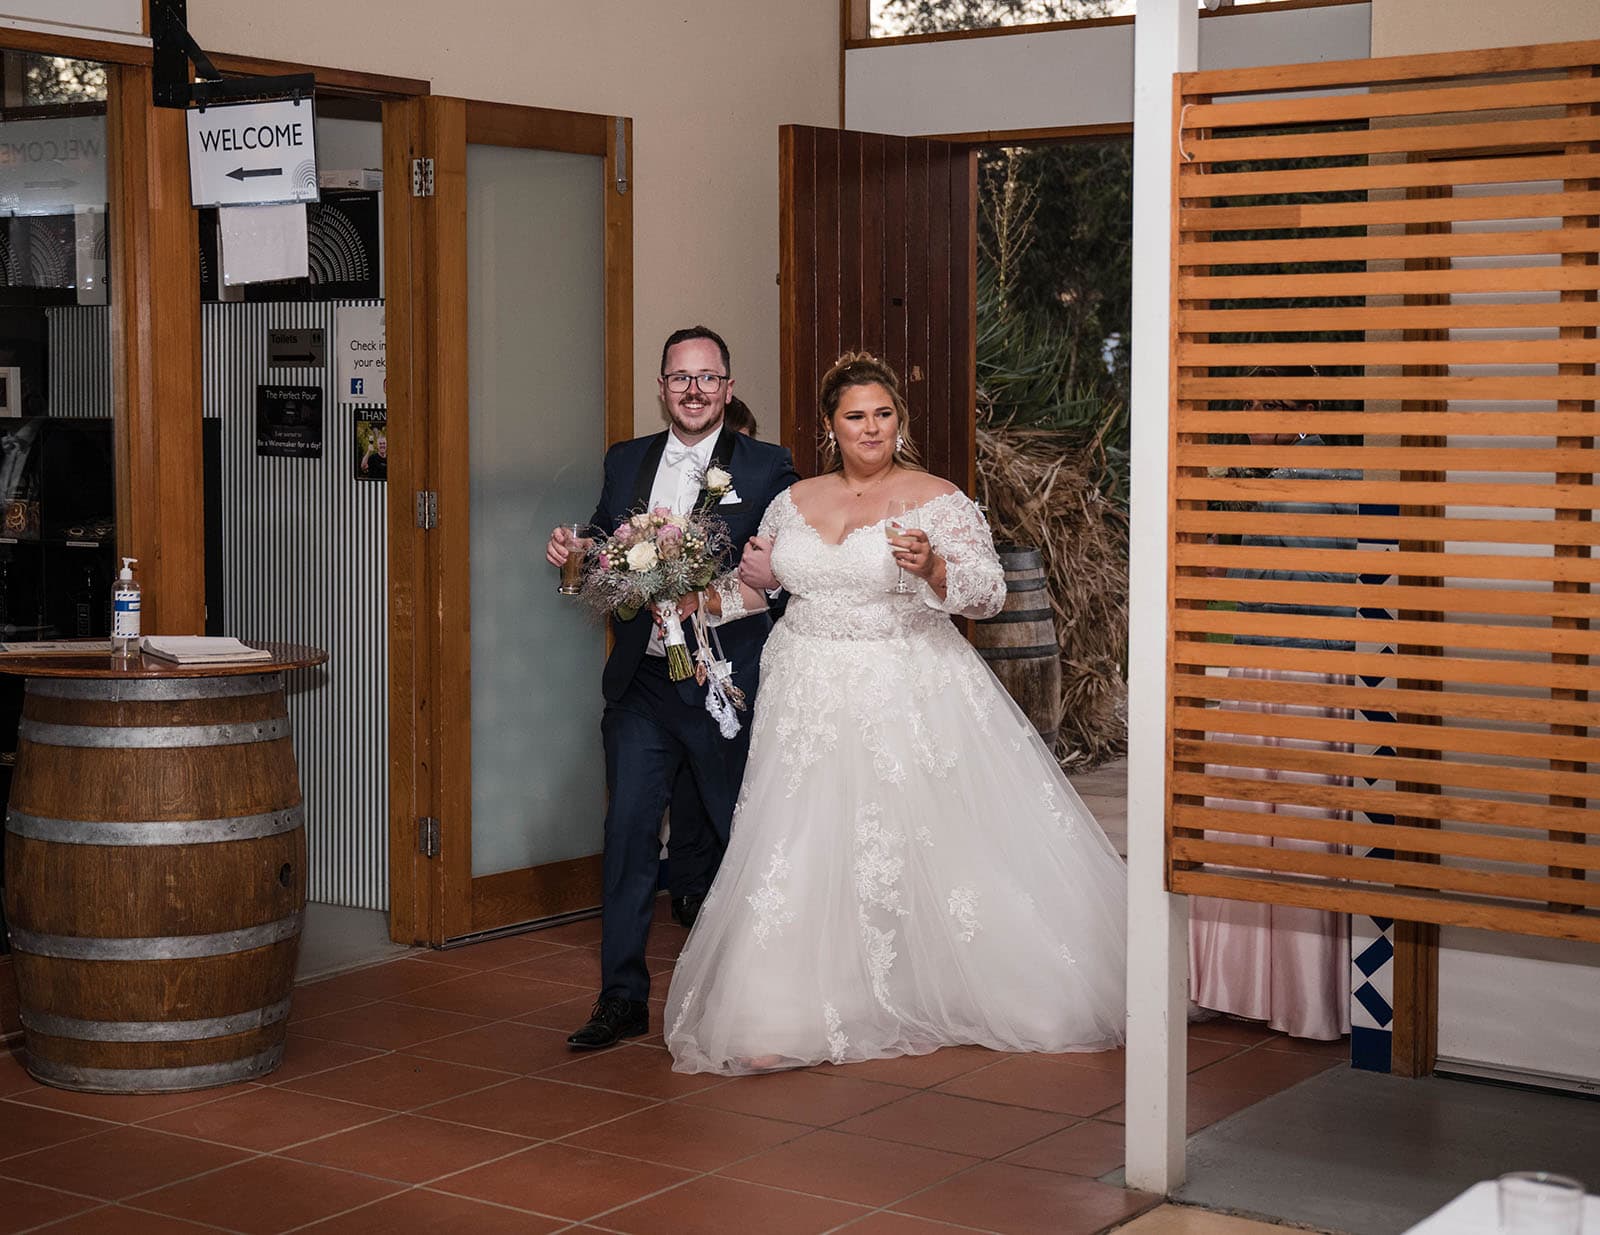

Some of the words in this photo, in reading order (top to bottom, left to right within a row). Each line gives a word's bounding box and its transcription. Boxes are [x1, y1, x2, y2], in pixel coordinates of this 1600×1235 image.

[200, 124, 303, 152] WELCOME
[271, 334, 298, 344] Toilets
[350, 340, 377, 351] Check
[353, 359, 374, 370] your
[265, 390, 278, 399] The
[279, 391, 301, 400] Perfect
[302, 391, 317, 400] Pour
[269, 440, 297, 448] Winemaker
[297, 441, 306, 449] for
